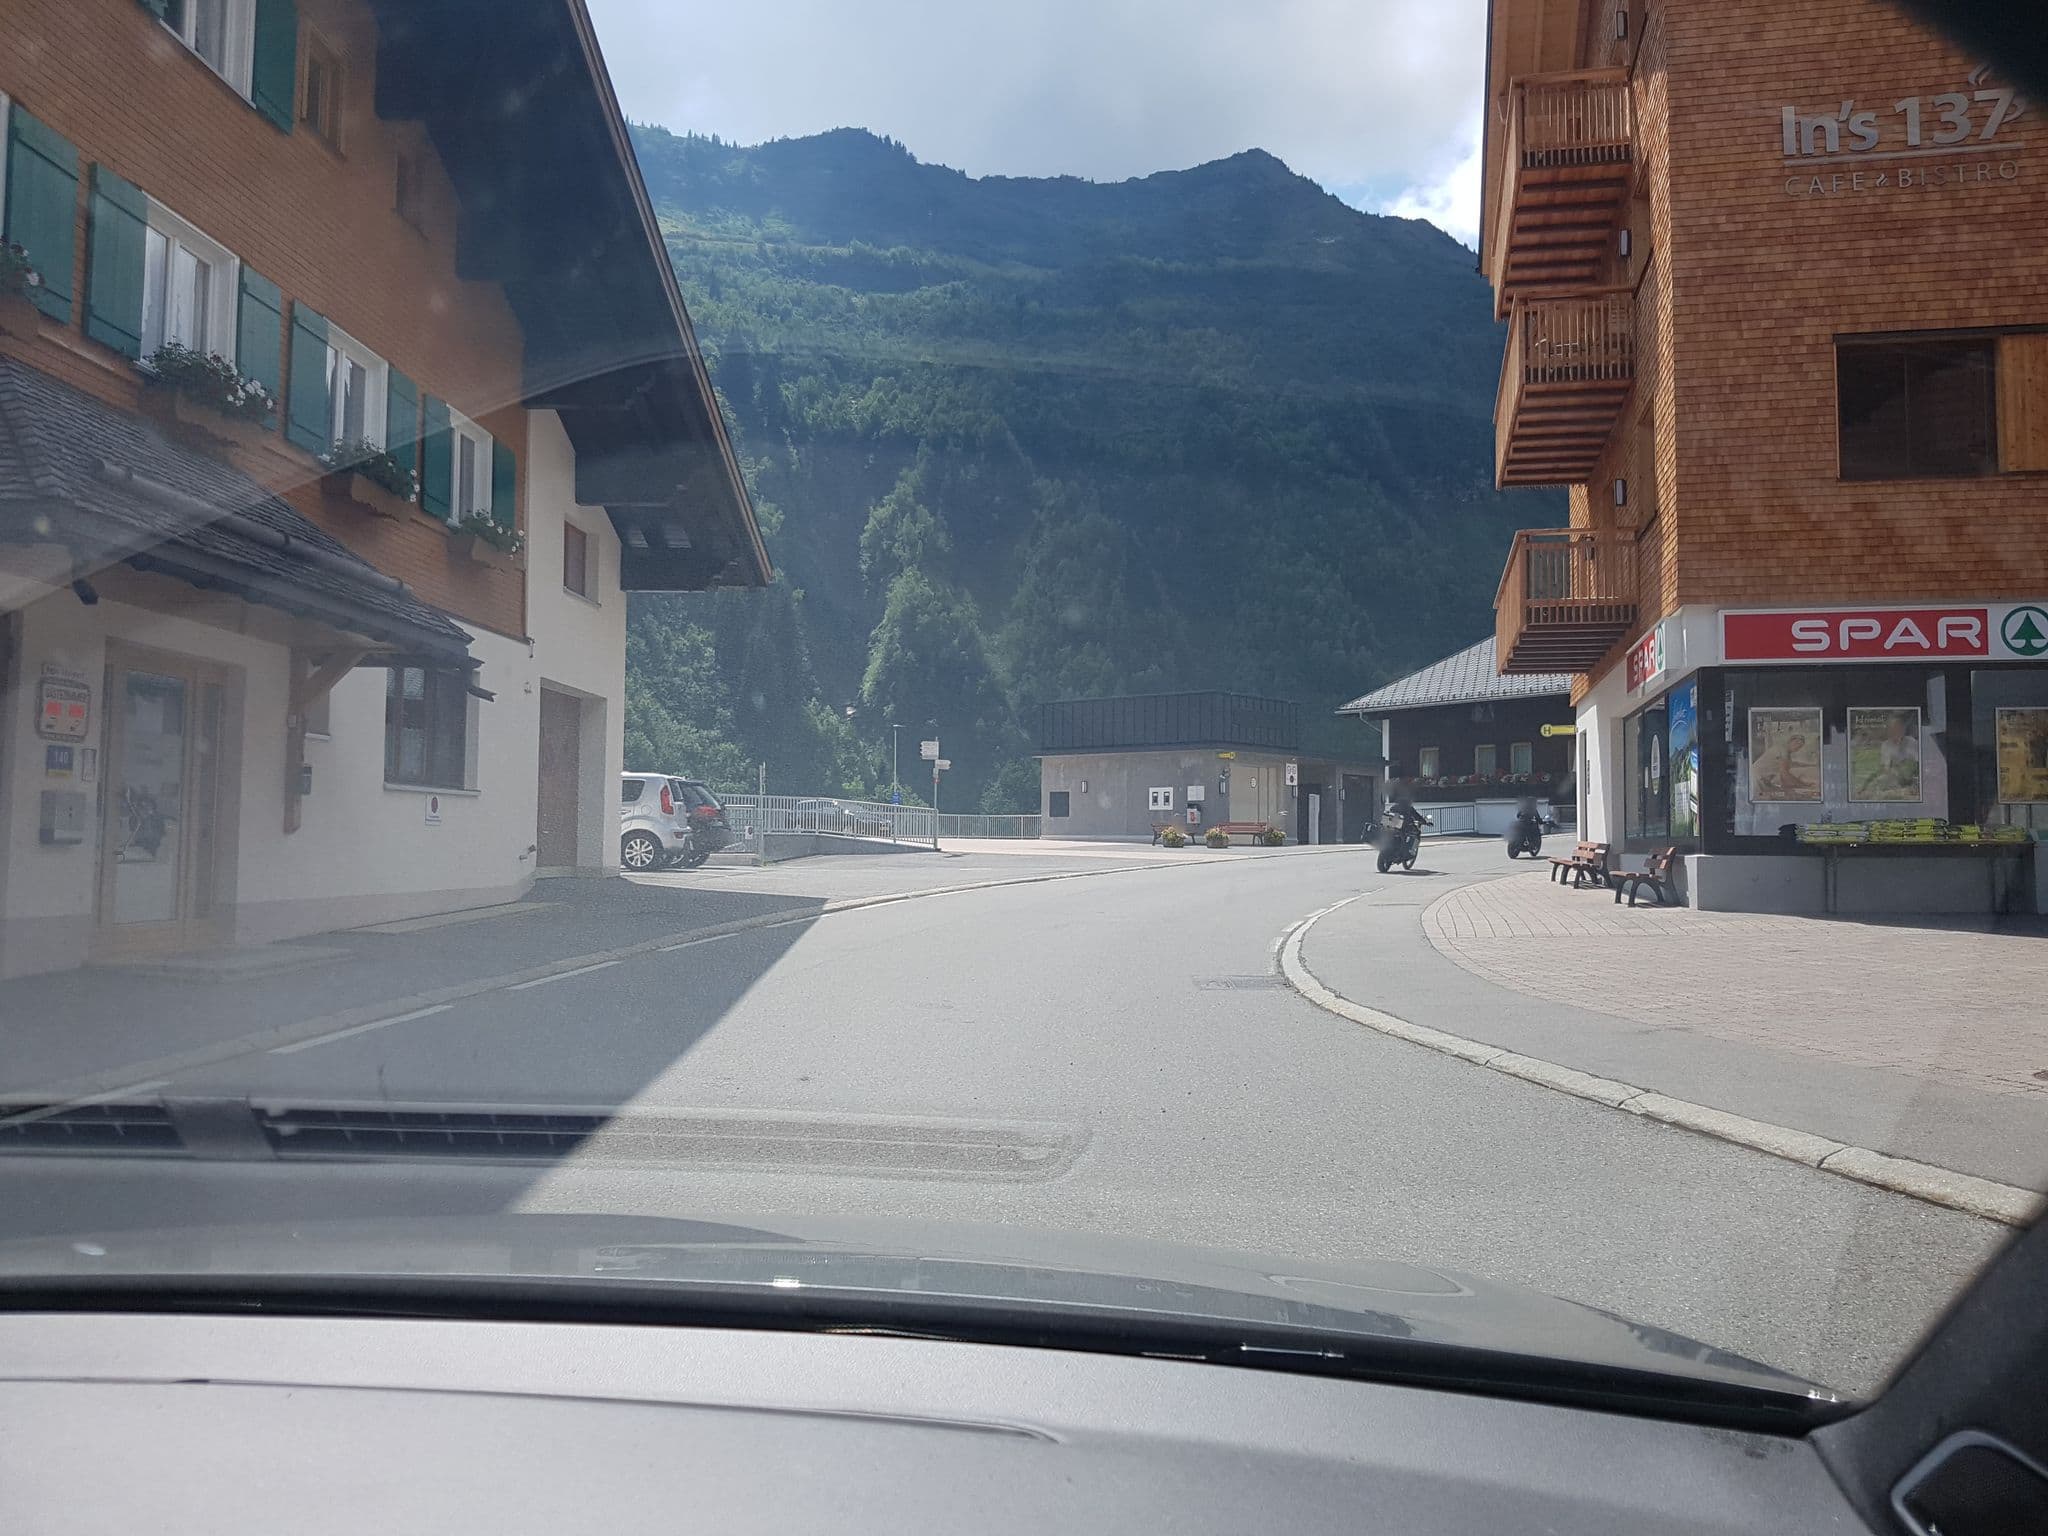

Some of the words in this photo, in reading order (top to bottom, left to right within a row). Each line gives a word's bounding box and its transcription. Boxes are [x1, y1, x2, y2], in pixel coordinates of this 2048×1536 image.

[1782, 100, 1880, 156] In's
[1894, 87, 2016, 147] 137
[1784, 171, 1866, 197] CAFE
[1898, 160, 2019, 189] BISTRO
[1790, 615, 1983, 652] SPAR
[1633, 639, 1655, 682] SPAR
